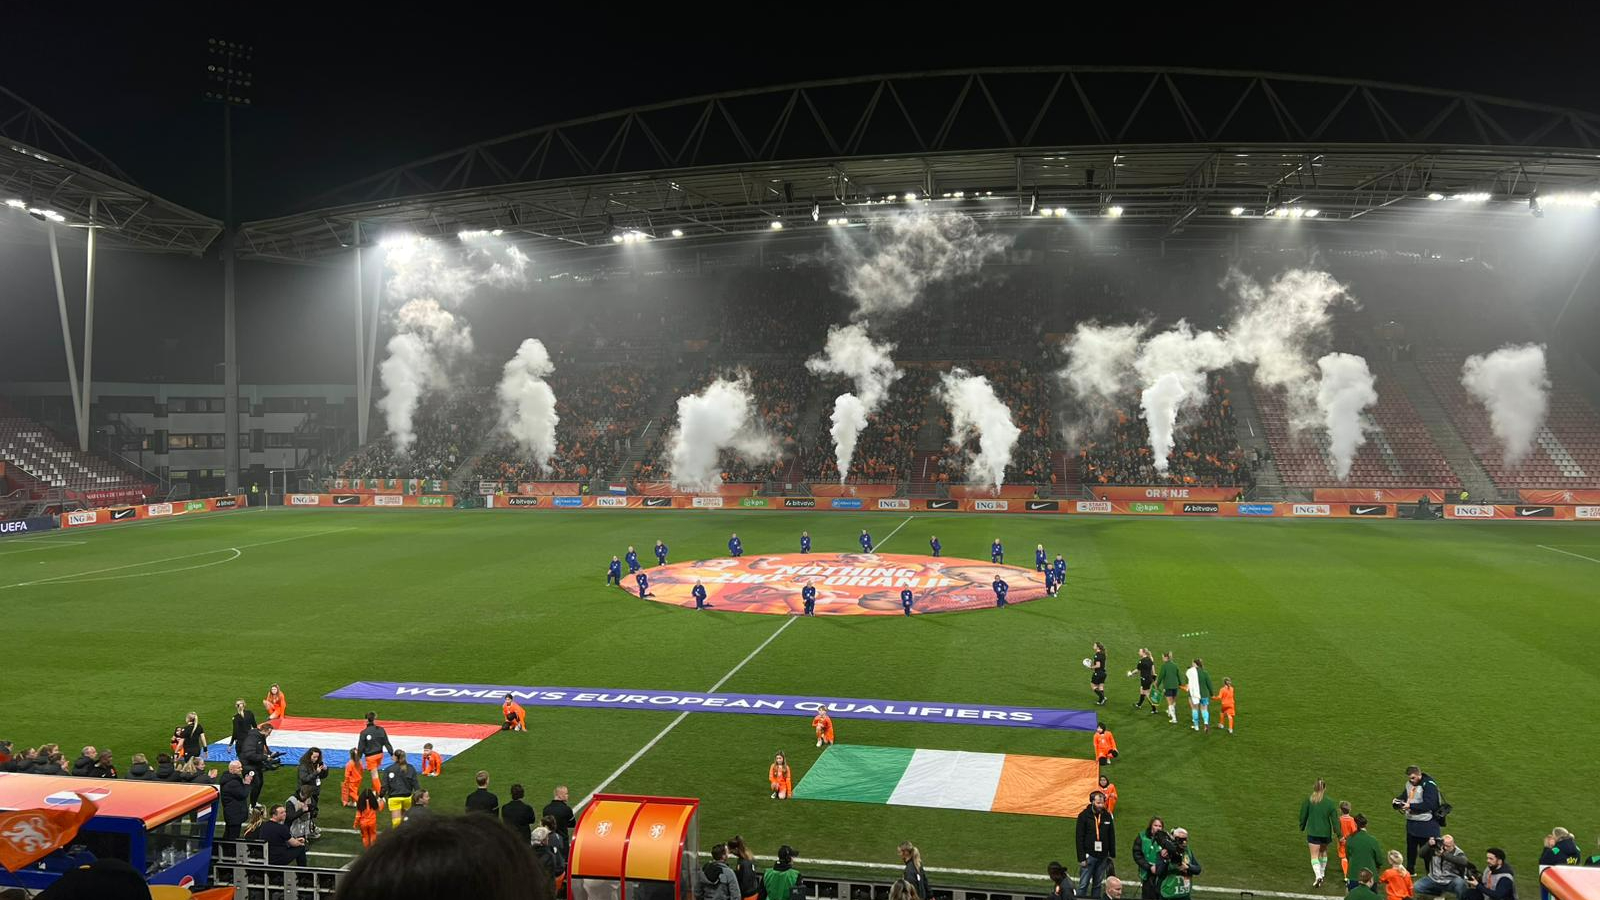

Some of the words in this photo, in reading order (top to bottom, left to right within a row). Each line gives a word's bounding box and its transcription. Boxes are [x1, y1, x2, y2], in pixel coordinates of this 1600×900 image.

[70, 516, 86, 524] ING
[1, 521, 28, 532] UEFA
[774, 566, 917, 577] NOTHING
[396, 687, 567, 699] WOMEN'S
[572, 693, 784, 709] EUROPEAN
[794, 702, 1033, 721] QUALIFIERS
